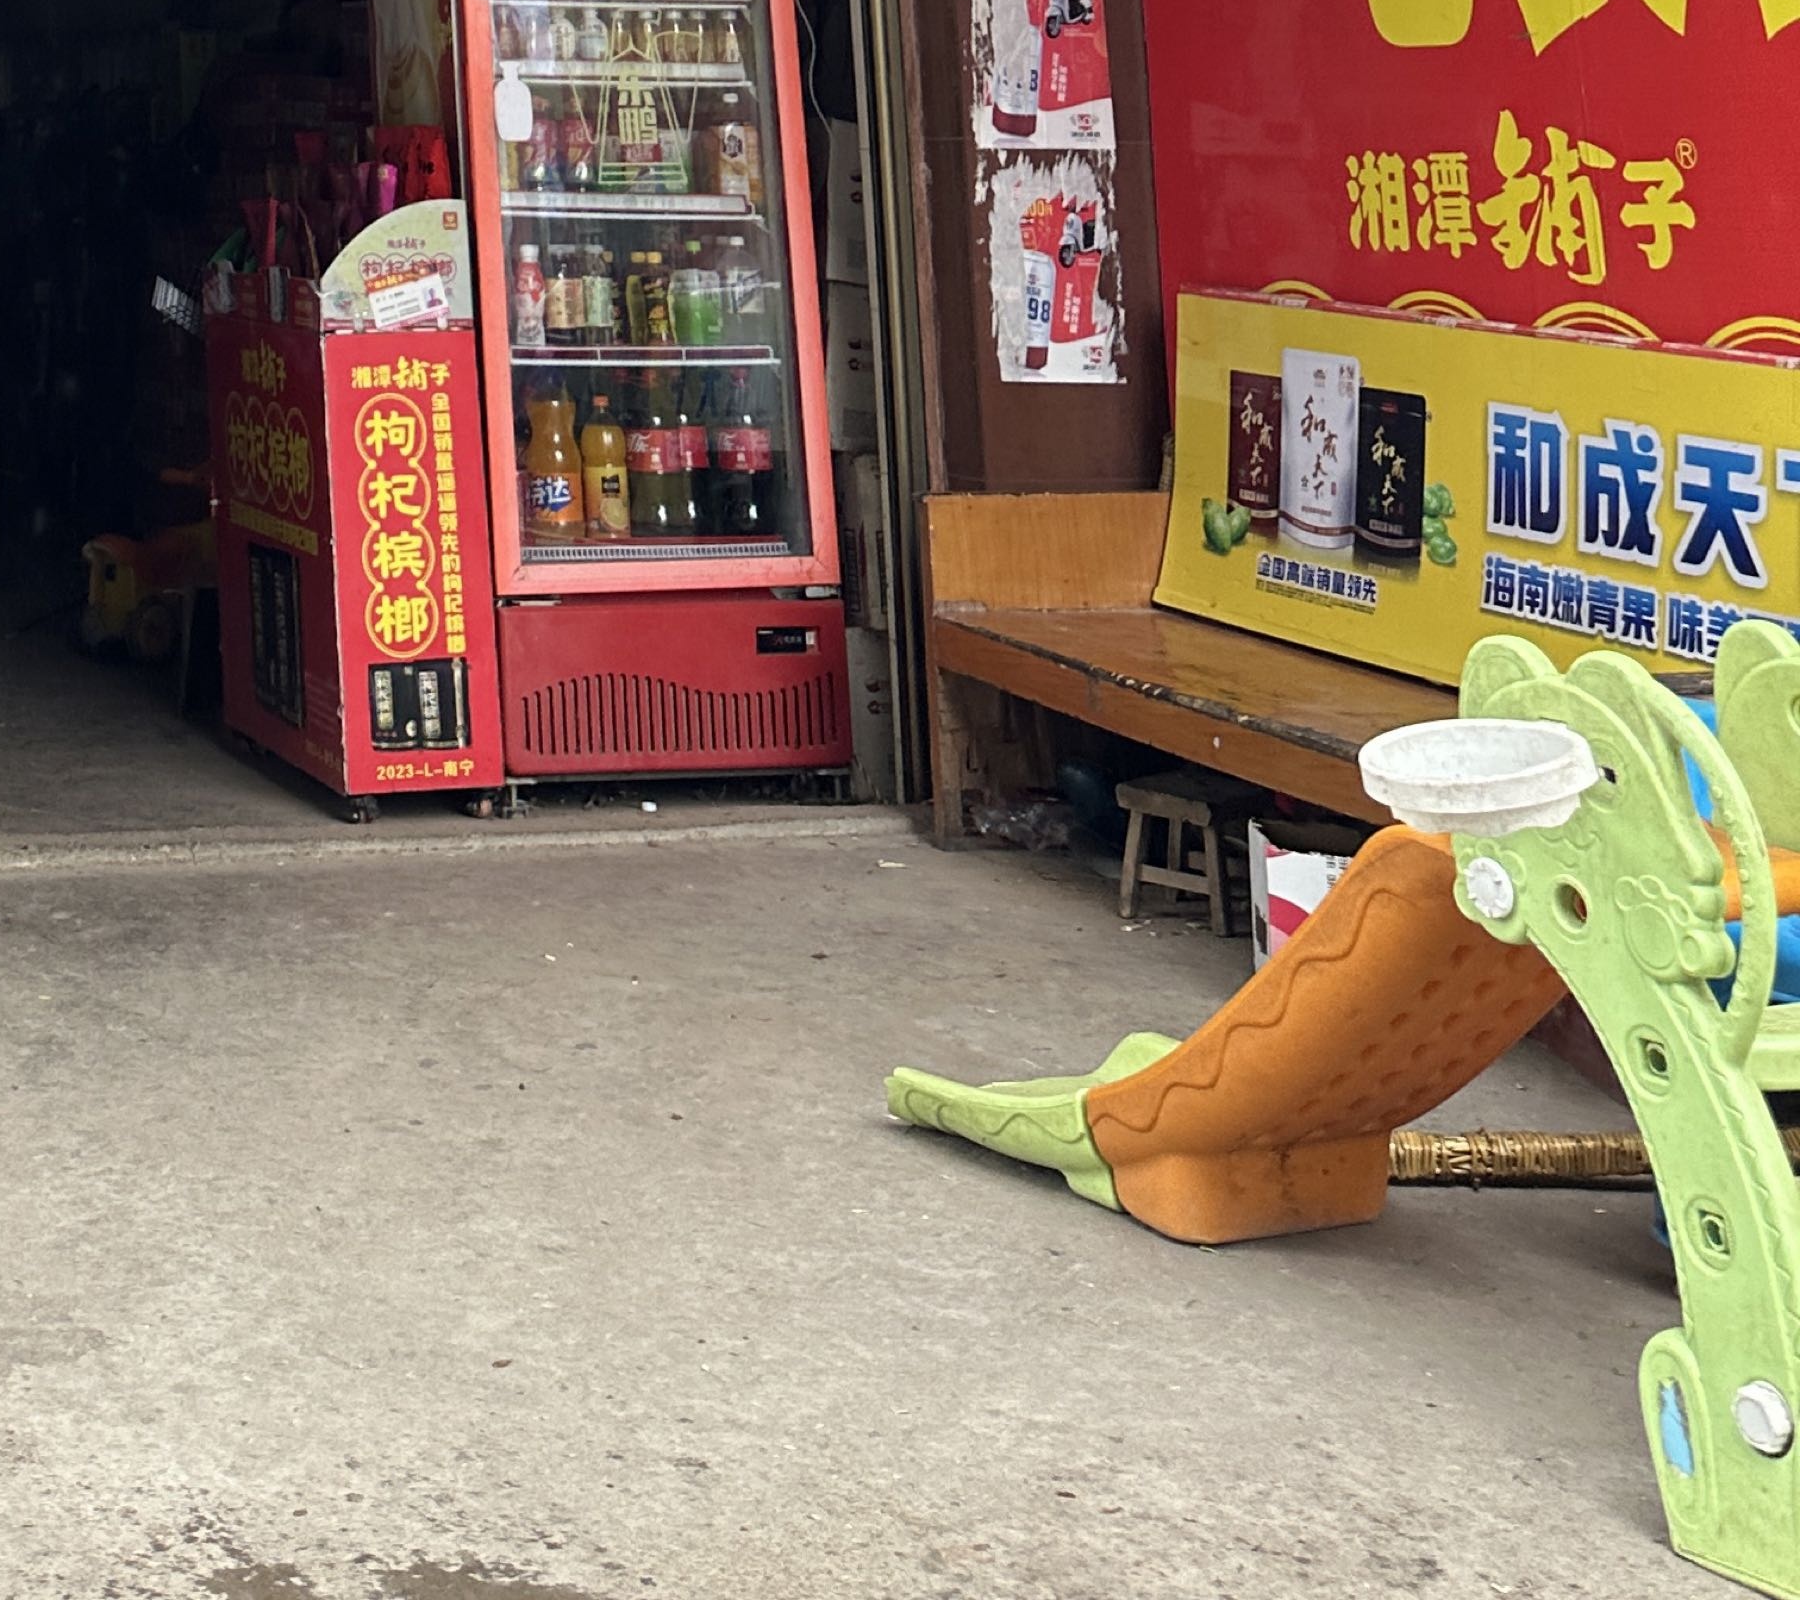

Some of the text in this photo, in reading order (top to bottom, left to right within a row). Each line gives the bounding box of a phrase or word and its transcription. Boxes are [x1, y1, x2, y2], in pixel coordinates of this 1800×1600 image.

[1344, 107, 1698, 286] 湘潭铺子
[351, 355, 452, 393] 湘潭铺子
[365, 409, 431, 647] 枸杞槟榔
[1493, 410, 1800, 579] 和成天
[1483, 554, 1656, 644] 海南嫩青果
[376, 759, 475, 781] 2023-L-南宁
